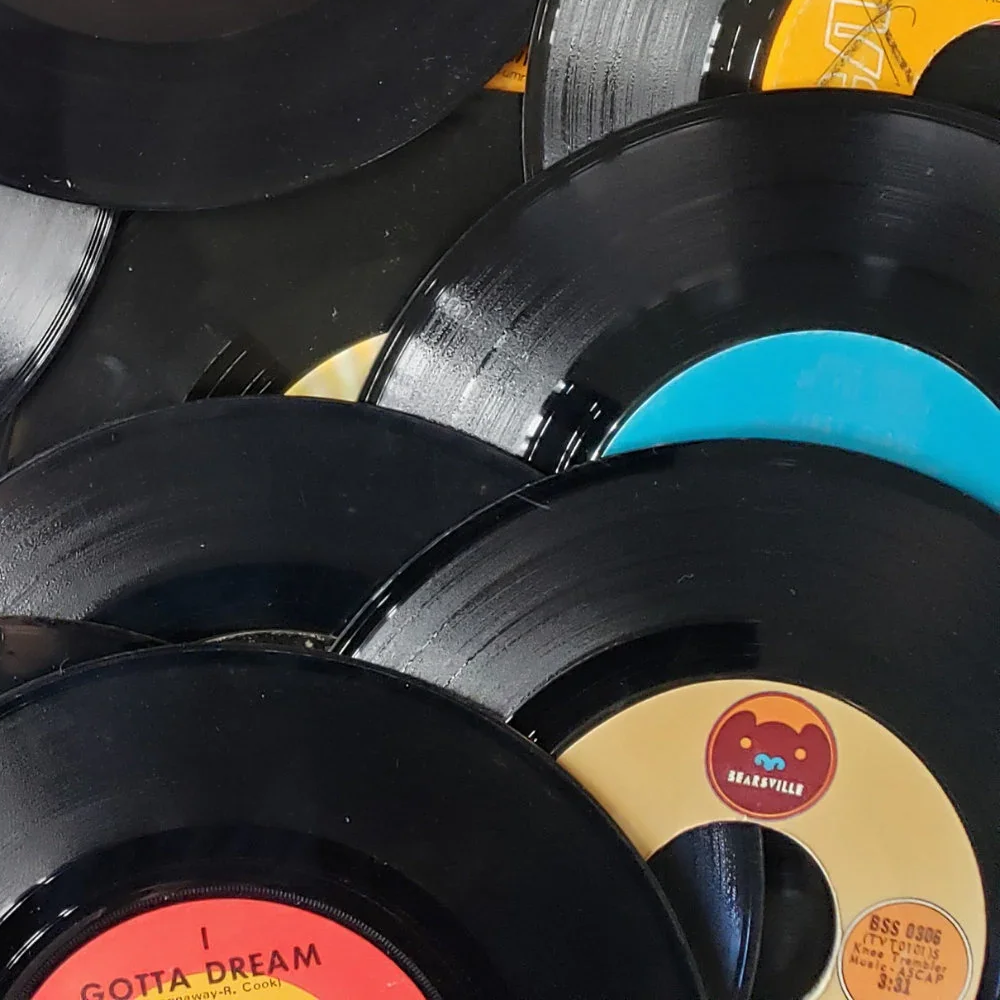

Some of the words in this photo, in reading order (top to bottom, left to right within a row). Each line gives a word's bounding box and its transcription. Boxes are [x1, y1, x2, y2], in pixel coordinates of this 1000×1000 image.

[727, 770, 804, 797] BEARSVILLE
[869, 914, 901, 937] BSS
[200, 927, 210, 950] I
[80, 967, 191, 1000] GOTTA
[205, 943, 322, 985] DREAM
[242, 977, 282, 993] Cook)
